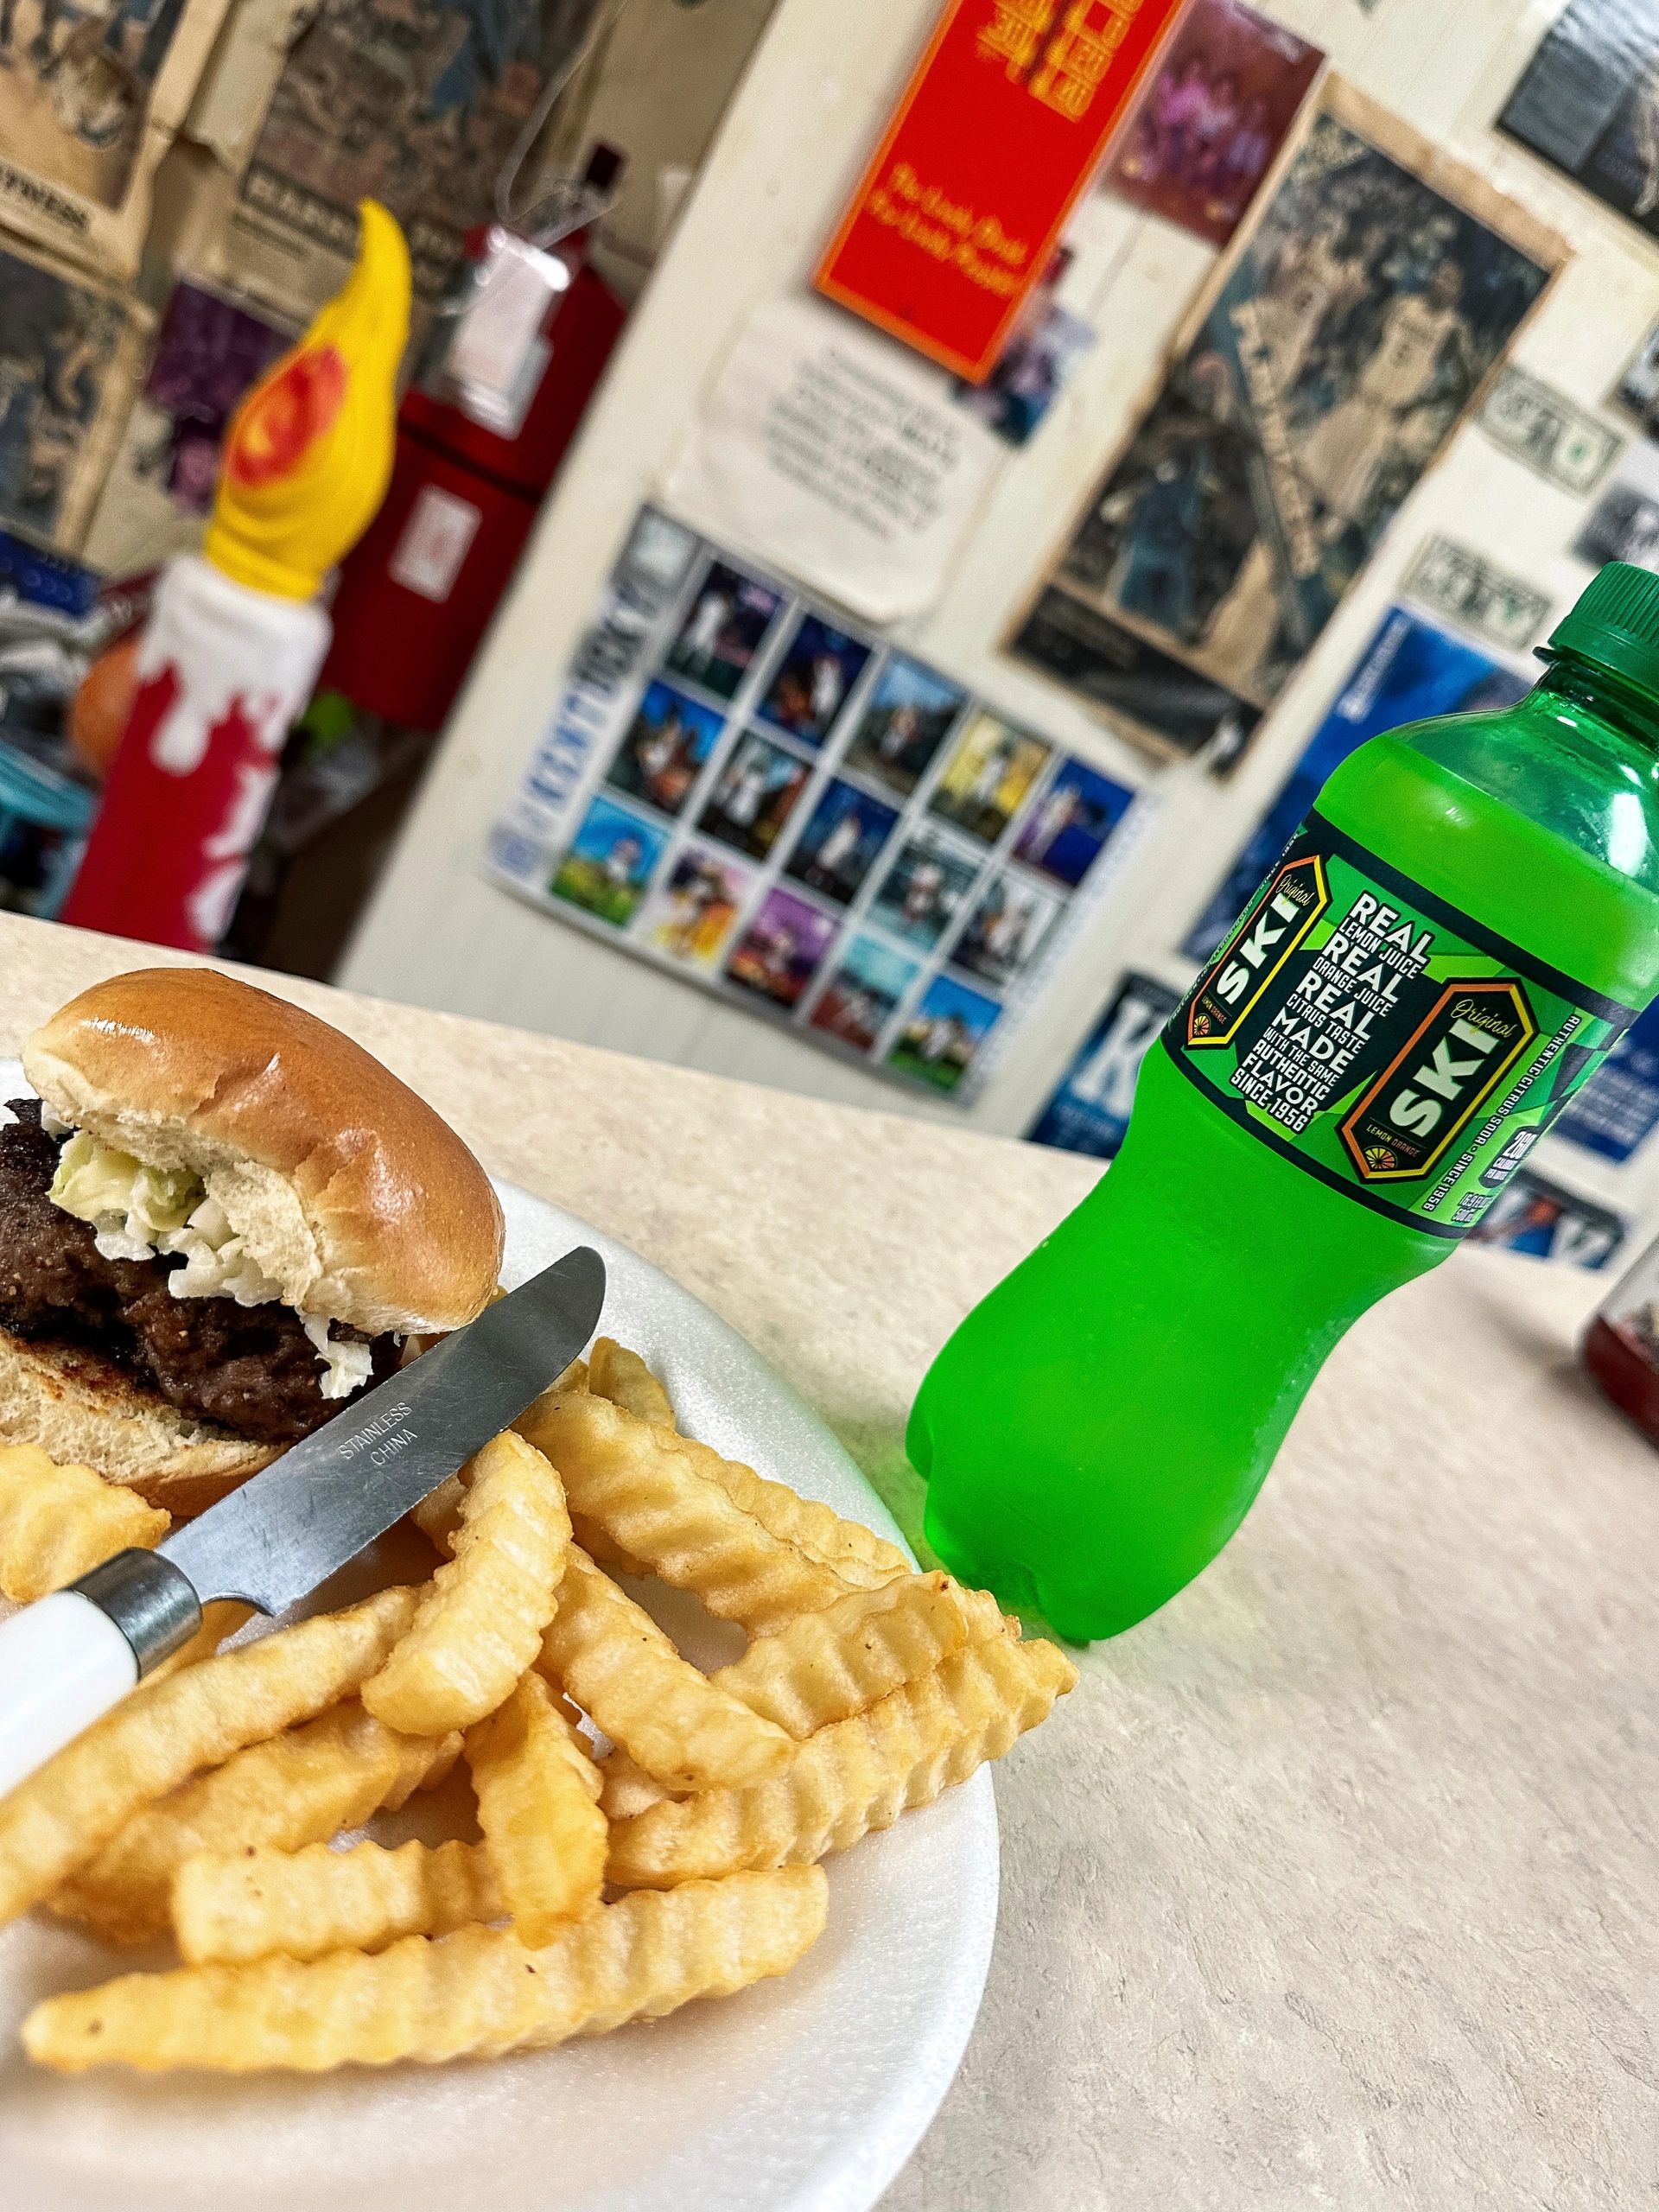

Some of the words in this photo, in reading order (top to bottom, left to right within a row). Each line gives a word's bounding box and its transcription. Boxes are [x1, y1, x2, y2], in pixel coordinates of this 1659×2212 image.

[1275, 874, 1316, 906] Original
[1217, 893, 1300, 1005] SKI
[1339, 917, 1382, 954] LEMON
[1379, 947, 1421, 979] JUICE
[1350, 893, 1432, 964] REAL
[1313, 957, 1357, 993] ORANGE
[1354, 987, 1394, 1017] JUICE
[1322, 931, 1402, 1003] REAL
[1286, 993, 1327, 1028] CITRUS
[1325, 1020, 1365, 1054] TASTE
[1294, 969, 1374, 1041] REAL
[1450, 999, 1518, 1038] Original
[1253, 1039, 1331, 1101] AUTHENTIC
[1262, 1027, 1290, 1052] WITH
[1287, 1043, 1310, 1067] THE
[1307, 1060, 1340, 1087] SAME
[1271, 1007, 1355, 1075] MADE
[1529, 1015, 1580, 1076] AUTHENTIC
[1230, 1068, 1274, 1107] SINCE
[1269, 1097, 1308, 1132] 1956
[1241, 1052, 1319, 1116] FLAVOR
[1389, 1018, 1500, 1138] SKI
[1498, 1076, 1533, 1116] CITRUS
[1366, 1124, 1392, 1143] LEMON
[1391, 1139, 1421, 1158] ORANGE
[1475, 1115, 1502, 1146] SODA
[1502, 1131, 1537, 1160] 260
[1423, 1183, 1452, 1211] 1956
[1443, 1153, 1473, 1185] SINCE
[337, 1402, 413, 1460] STAINLESS
[370, 1428, 418, 1465] CHINA
